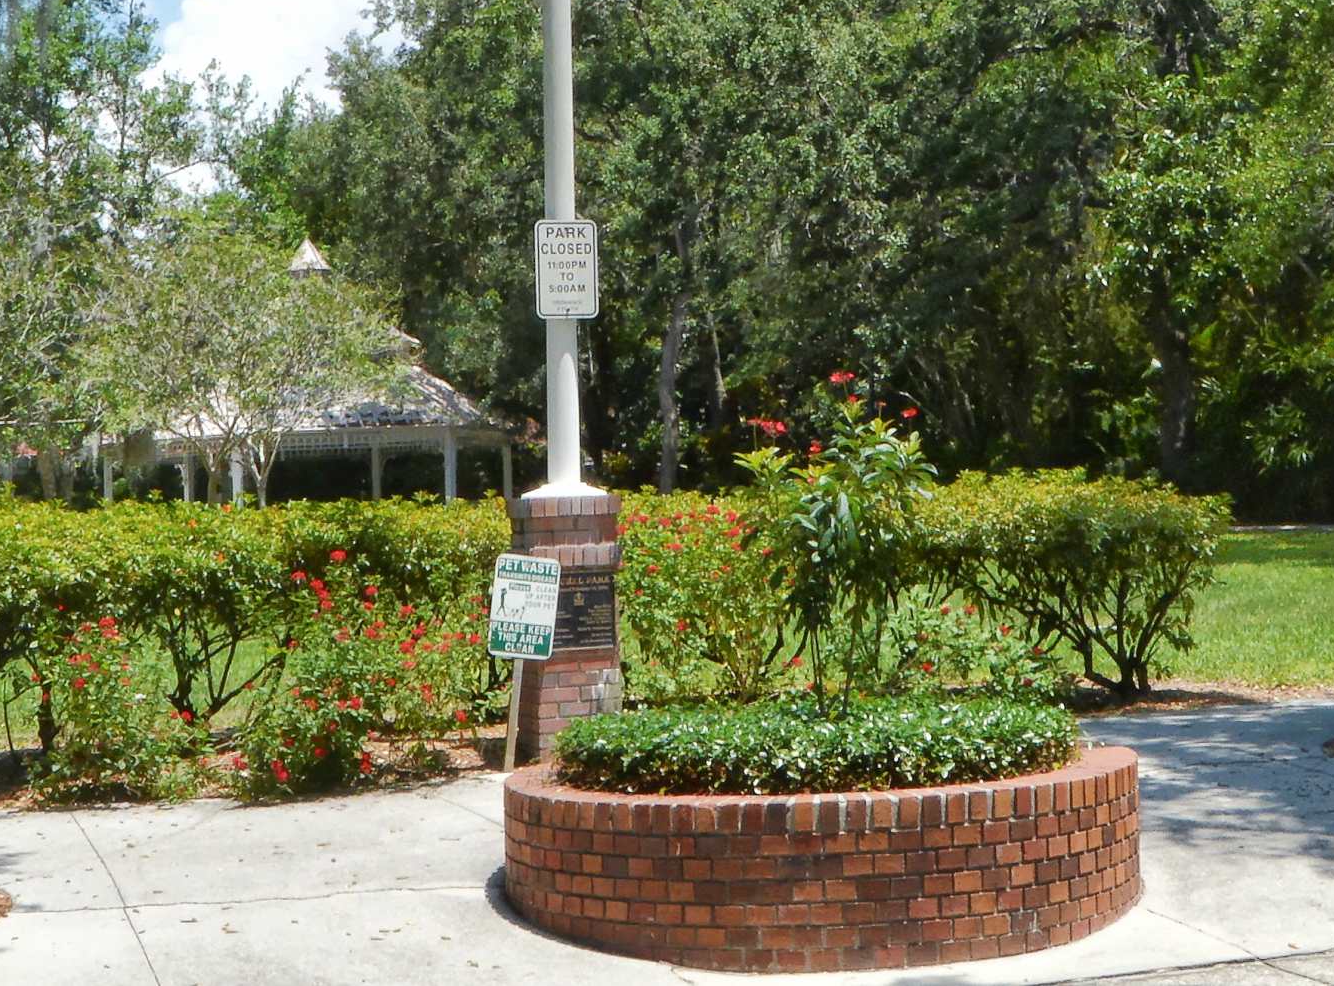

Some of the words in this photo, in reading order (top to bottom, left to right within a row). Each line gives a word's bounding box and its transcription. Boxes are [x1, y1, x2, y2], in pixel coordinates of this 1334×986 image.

[546, 227, 587, 239] PARK
[540, 243, 592, 255] CLOSED
[559, 272, 575, 282] TO
[547, 284, 587, 293] 5:00AM
[498, 558, 519, 571] PET
[521, 560, 558, 576] WASTE
[491, 621, 526, 634] PLEASE
[528, 624, 551, 636] KEEP
[498, 631, 517, 643] THIS
[519, 634, 544, 646] AREA
[504, 642, 535, 655] CLEAN
